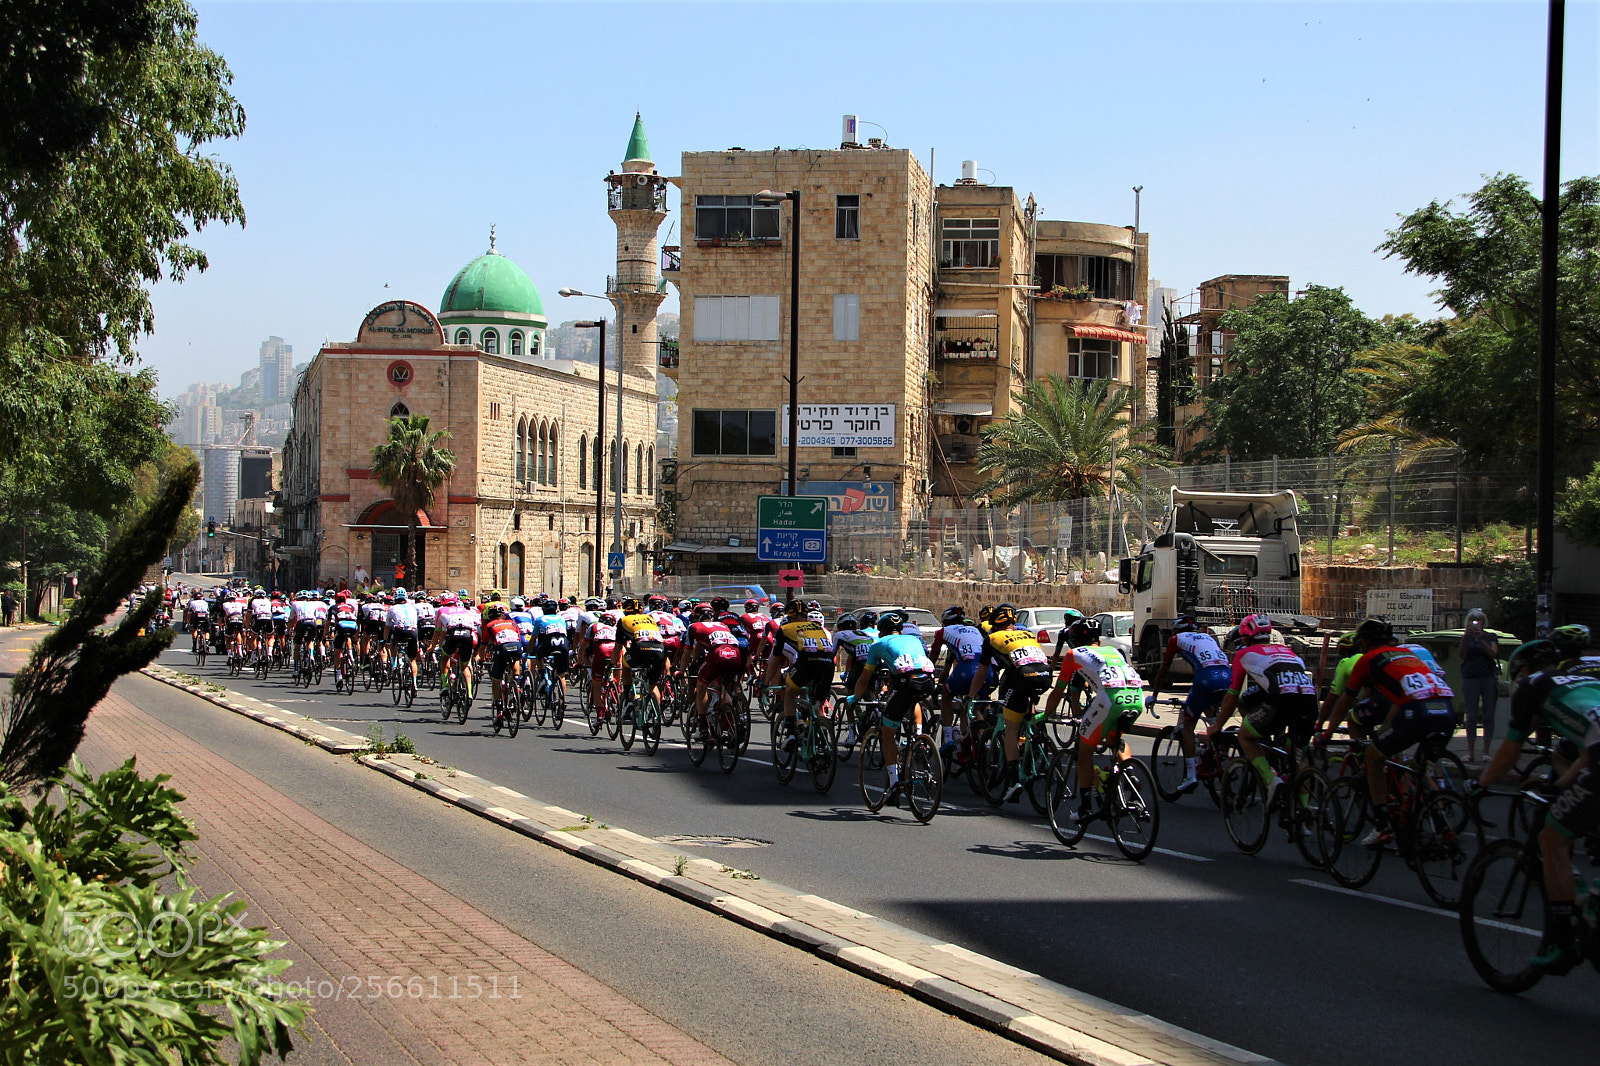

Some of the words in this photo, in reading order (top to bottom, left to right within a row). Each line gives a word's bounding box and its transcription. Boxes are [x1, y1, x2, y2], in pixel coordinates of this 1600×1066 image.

[845, 407, 869, 416] דוד
[874, 407, 889, 420] בן
[843, 420, 881, 433] חוקר
[840, 436, 893, 446] 077-3005826
[776, 532, 799, 541] קריות
[773, 550, 801, 558] Krayot
[961, 643, 973, 654] 83
[1199, 650, 1212, 661] 85
[1406, 674, 1424, 690] 45
[1115, 694, 1140, 706] CSF
[1551, 783, 1593, 820] BORA
